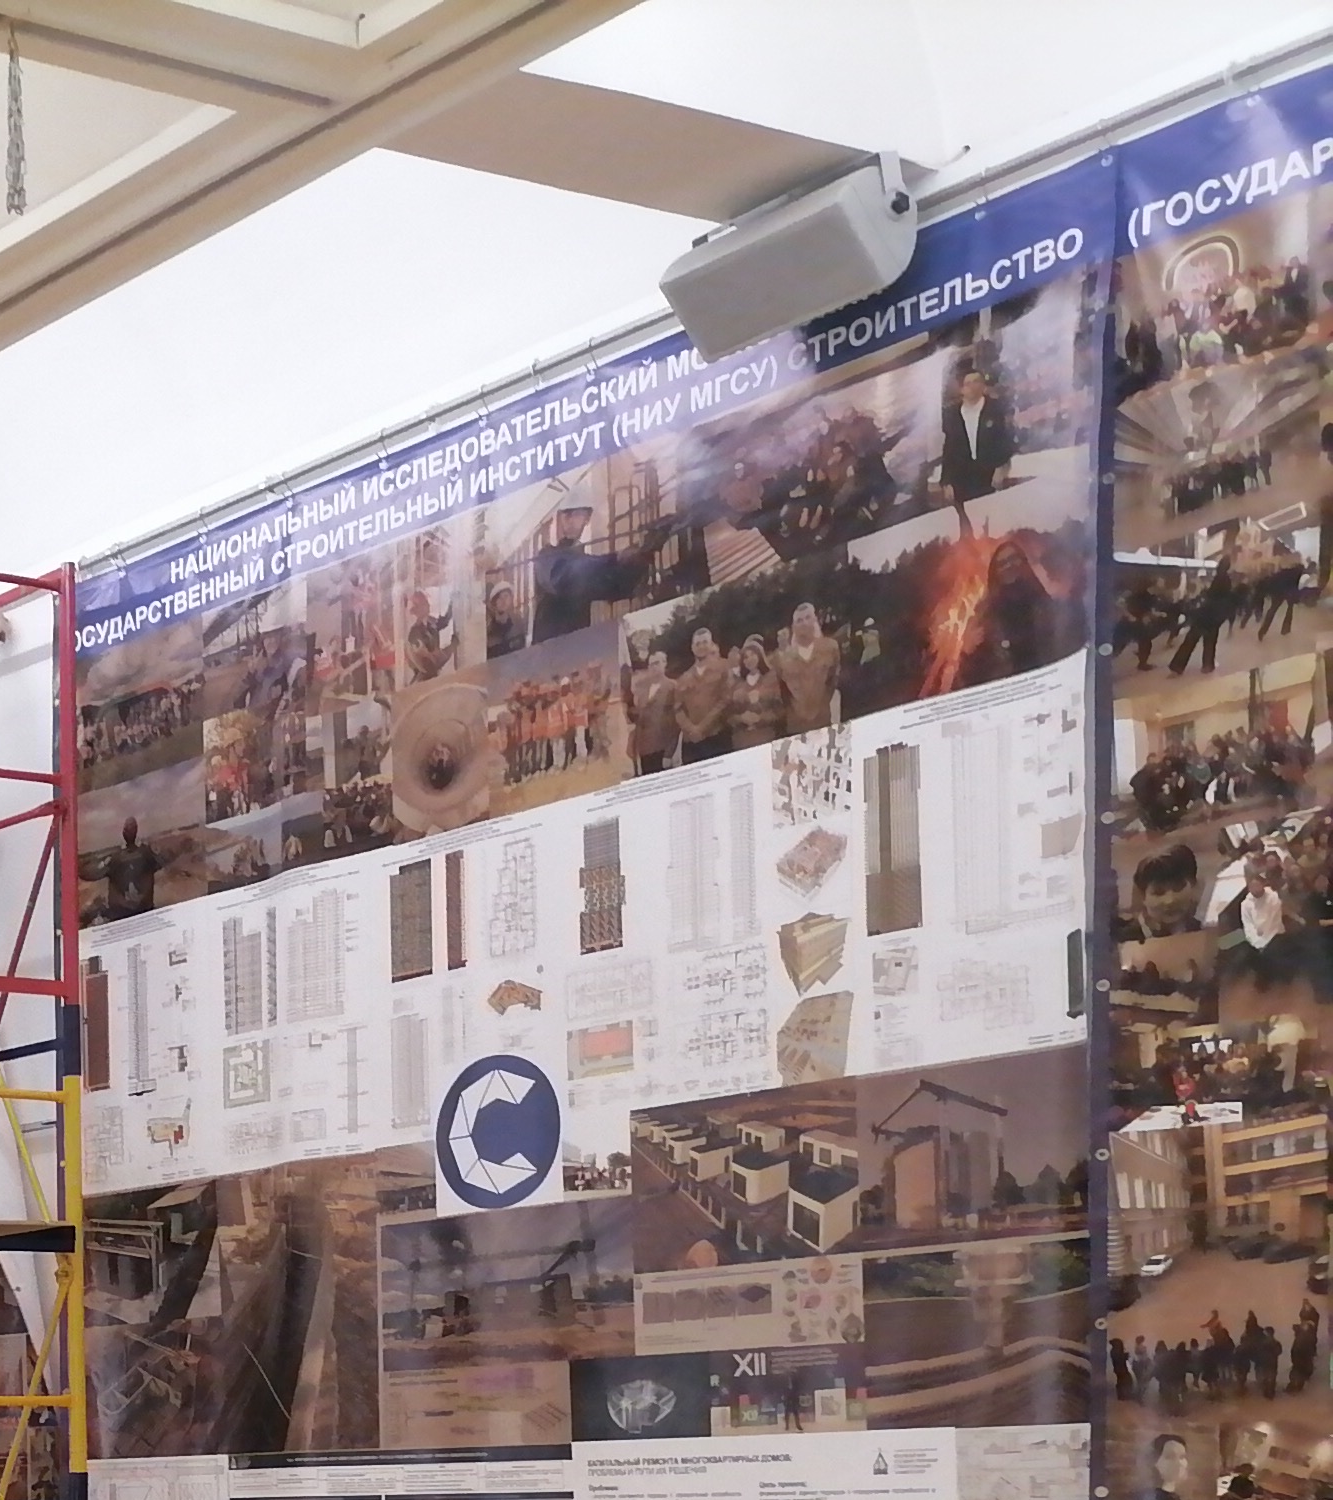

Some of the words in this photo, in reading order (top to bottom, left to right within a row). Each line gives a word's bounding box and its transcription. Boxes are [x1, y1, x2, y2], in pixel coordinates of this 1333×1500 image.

[75, 556, 265, 653] СУДАРСТВЕННЫЙ
[270, 474, 464, 575] СТРОИТЕЛЬНЫЙ
[470, 420, 605, 498] ИНСТИТУТ
[612, 392, 683, 447] (НИУ
[690, 354, 778, 413] МГСУ)
[787, 227, 1084, 370] СТРОИТЕЛЬСТВО
[170, 482, 355, 584] НАЦИОНАЛЬНЫЙ
[363, 360, 658, 506] ИССЛЕДОВАТЕЛЬСКИЙ
